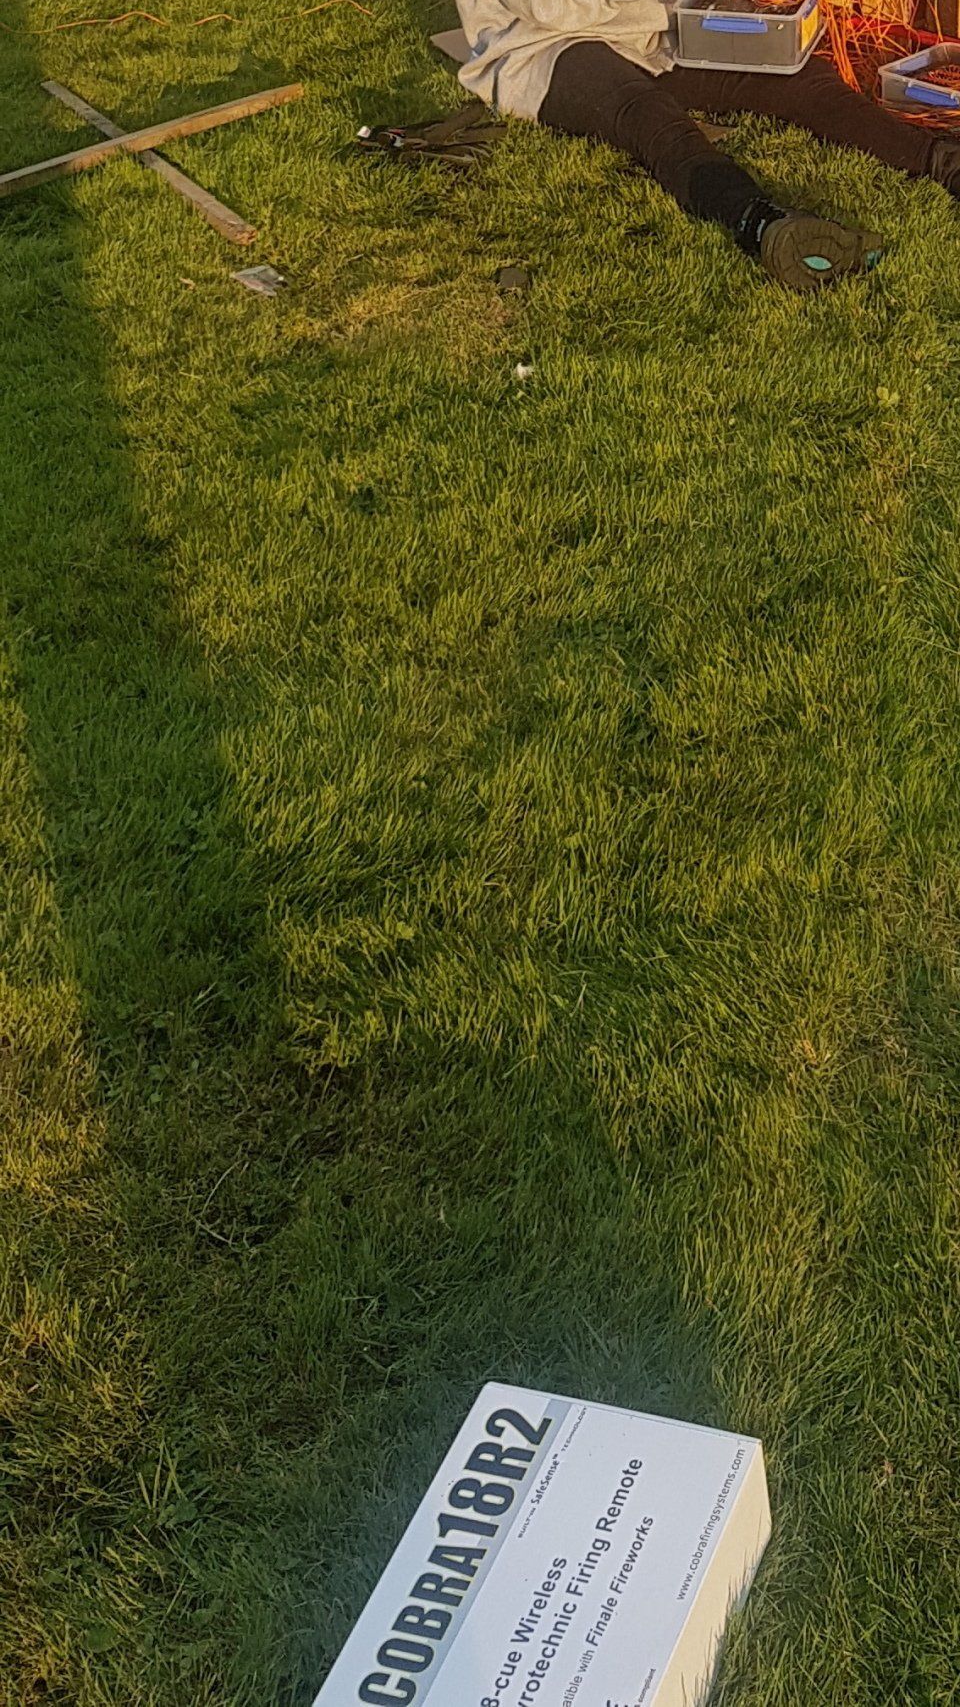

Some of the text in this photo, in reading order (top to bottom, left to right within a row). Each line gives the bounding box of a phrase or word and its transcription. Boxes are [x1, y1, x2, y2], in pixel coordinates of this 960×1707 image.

[357, 1407, 553, 1707] COBRA18R2
[566, 1537, 612, 1598] Firing
[595, 1458, 644, 1533] Remote
[610, 1516, 655, 1595] Fireworks
[676, 1448, 746, 1602] www.cobrafiringsystems.com
[510, 1557, 568, 1644] Wireless
[585, 1595, 619, 1647] Finale
[577, 1649, 596, 1674] with
